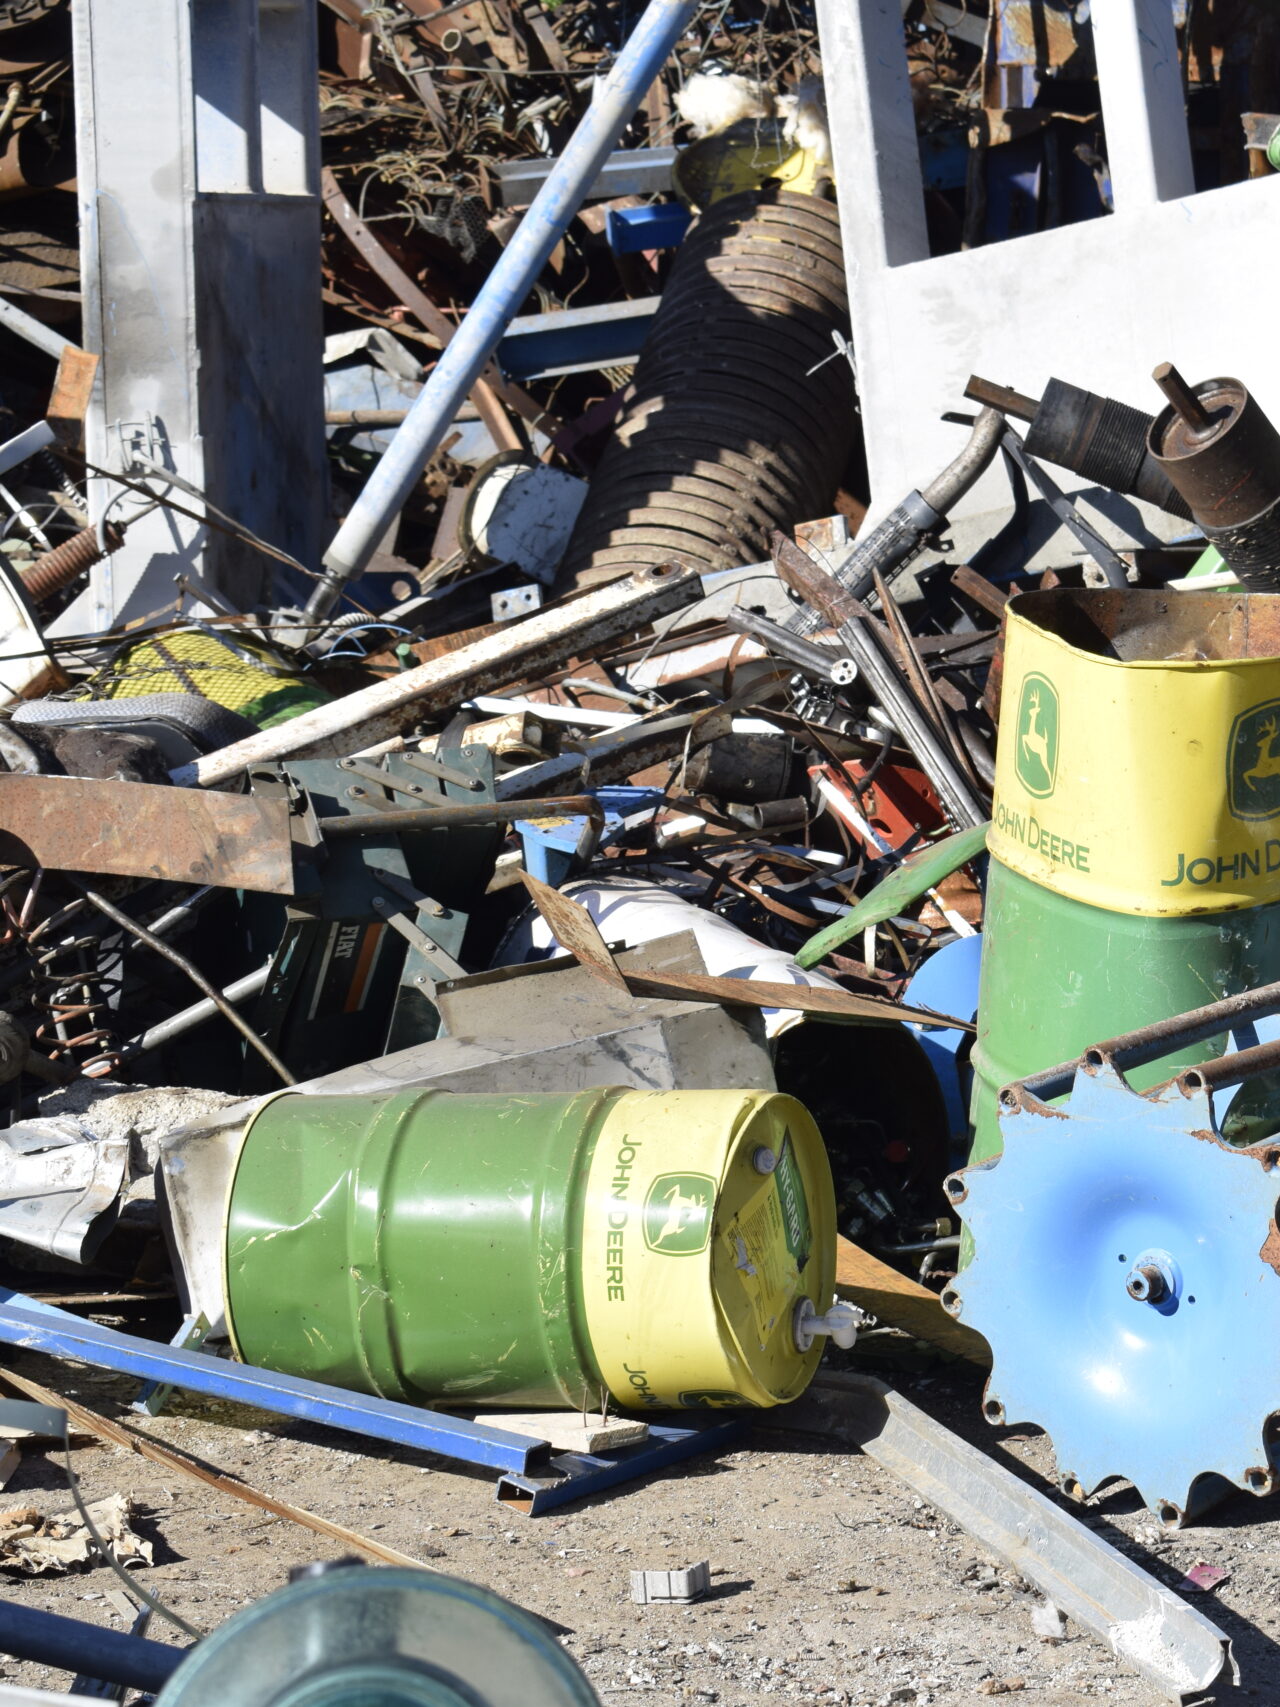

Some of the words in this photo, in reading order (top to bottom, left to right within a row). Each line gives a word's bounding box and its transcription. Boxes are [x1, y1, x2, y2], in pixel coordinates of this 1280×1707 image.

[994, 794, 1025, 844] JOHN
[1028, 816, 1090, 873] DEERE
[1161, 850, 1260, 887] JOHN
[335, 925, 360, 958] FIAT
[608, 1134, 642, 1200] JOHN
[606, 1211, 629, 1302] DEERE
